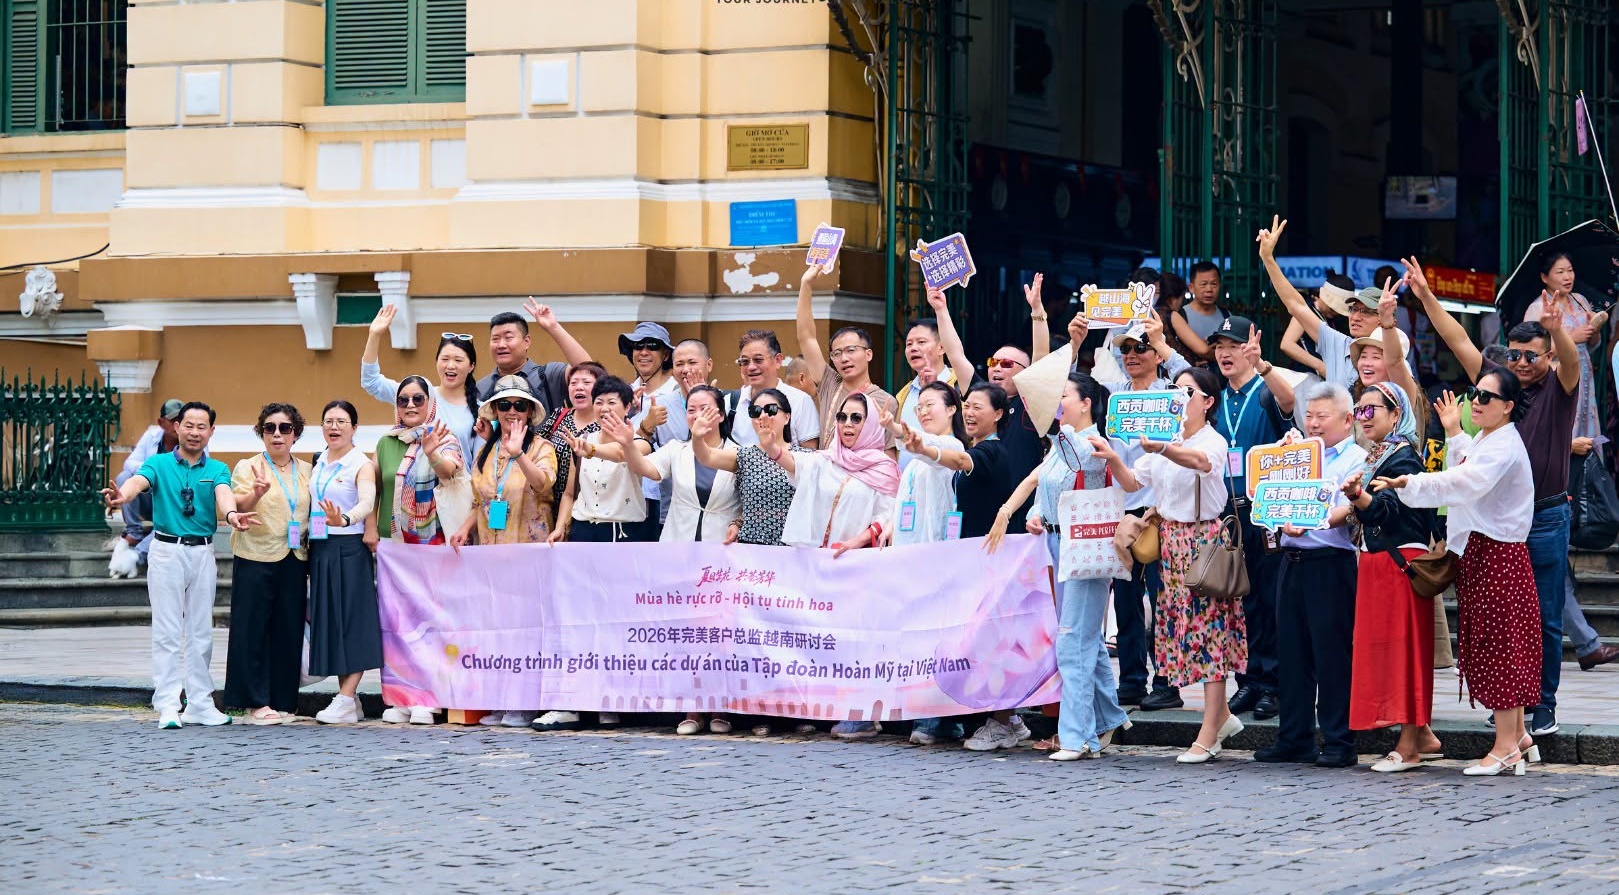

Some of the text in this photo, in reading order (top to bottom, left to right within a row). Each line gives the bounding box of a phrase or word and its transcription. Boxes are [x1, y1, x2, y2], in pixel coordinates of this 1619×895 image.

[922, 242, 958, 270] 选择完美
[1098, 293, 1131, 304] 越山海
[1091, 306, 1123, 318] 见完美
[1116, 397, 1169, 414] 西贡咖啡
[1120, 417, 1172, 433] 完美干杯
[1259, 448, 1311, 470] 你+完美
[1263, 487, 1317, 502] 西贡咖啡
[1265, 504, 1319, 519] 完美干杯
[635, 590, 663, 605] Mùa
[667, 591, 683, 605] hè
[686, 591, 706, 608] rực
[709, 590, 723, 604] rỡ
[733, 591, 754, 609] Hội
[758, 595, 772, 611] tụ
[776, 595, 805, 609] tinh
[809, 597, 834, 612] hoa
[627, 626, 837, 650] 2026年完美客户总监越南研讨会
[461, 652, 971, 683] Chương trình giới thiệu các dự án của Tập đoàn Hoàn Mỹ tại Việt Nam
